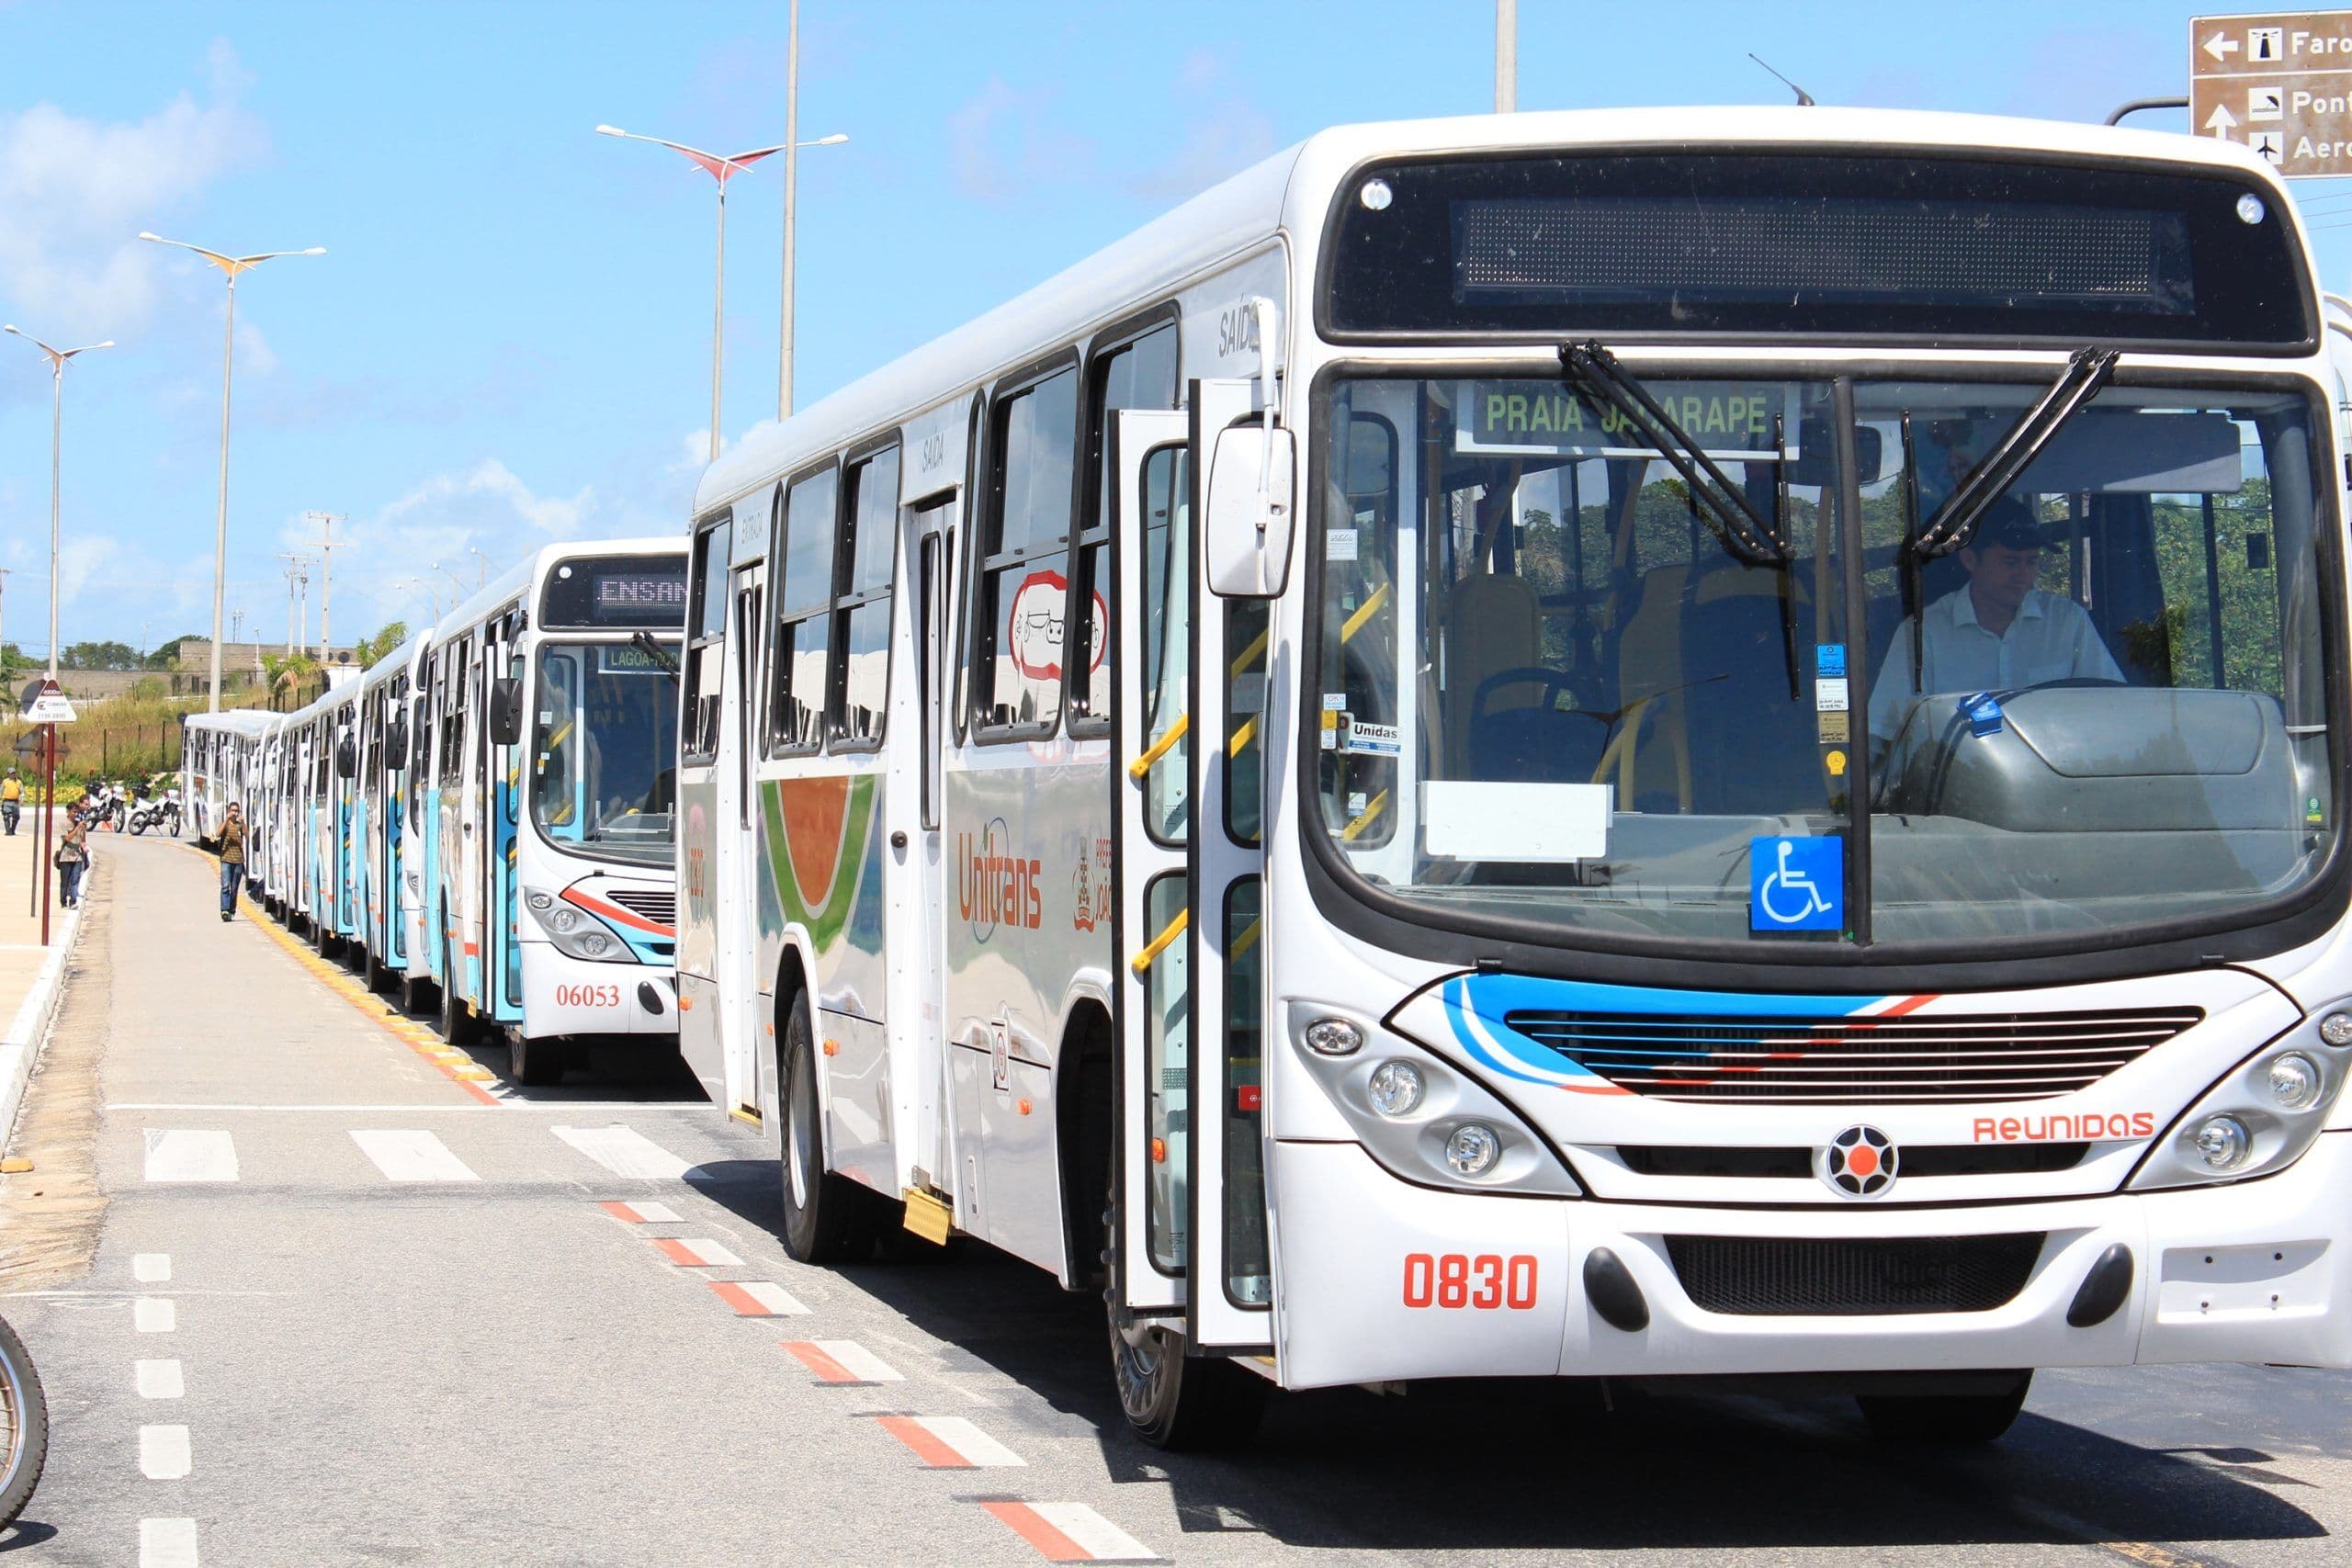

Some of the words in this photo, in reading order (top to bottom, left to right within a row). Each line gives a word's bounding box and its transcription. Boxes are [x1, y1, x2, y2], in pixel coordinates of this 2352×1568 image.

[2291, 31, 2352, 55] Faro
[1219, 293, 1250, 358] SAÍD
[1487, 394, 1584, 432] PRAIA
[1601, 390, 1767, 433] JAARAPÉ
[1354, 724, 1398, 739] Unidas
[958, 825, 1042, 931] Unitrans
[556, 984, 620, 1008] 06053
[1403, 1253, 1539, 1310] 0830
